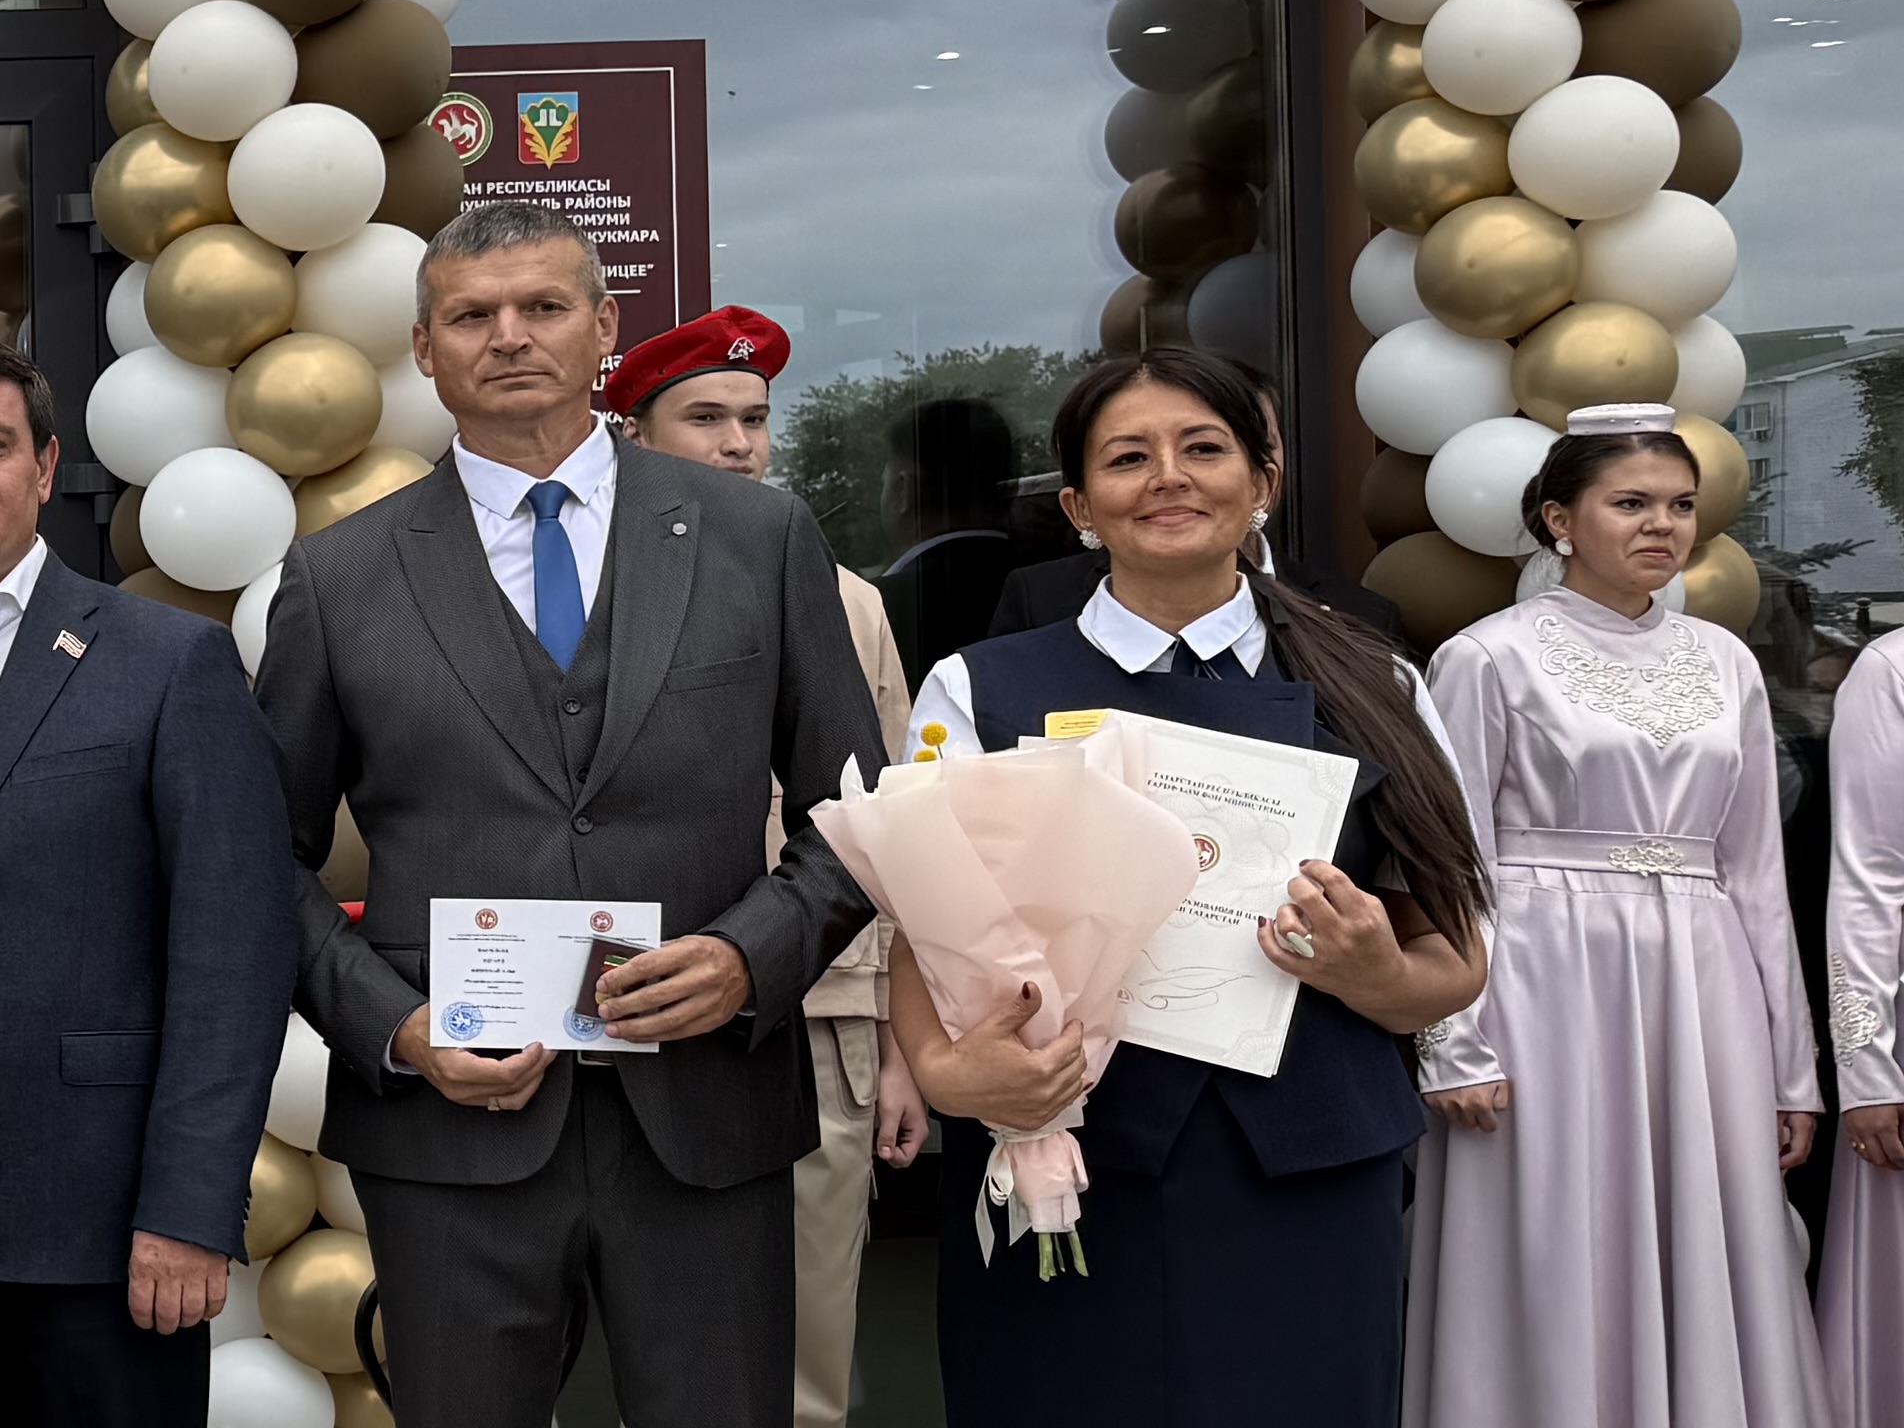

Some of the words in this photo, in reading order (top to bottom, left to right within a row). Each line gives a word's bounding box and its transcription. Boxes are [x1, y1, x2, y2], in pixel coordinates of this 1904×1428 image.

[486, 179, 611, 195] РЕСПУБЛИКАСЫ
[565, 194, 631, 210] РАЙОНЫ
[566, 213, 631, 226] ОМУМИ
